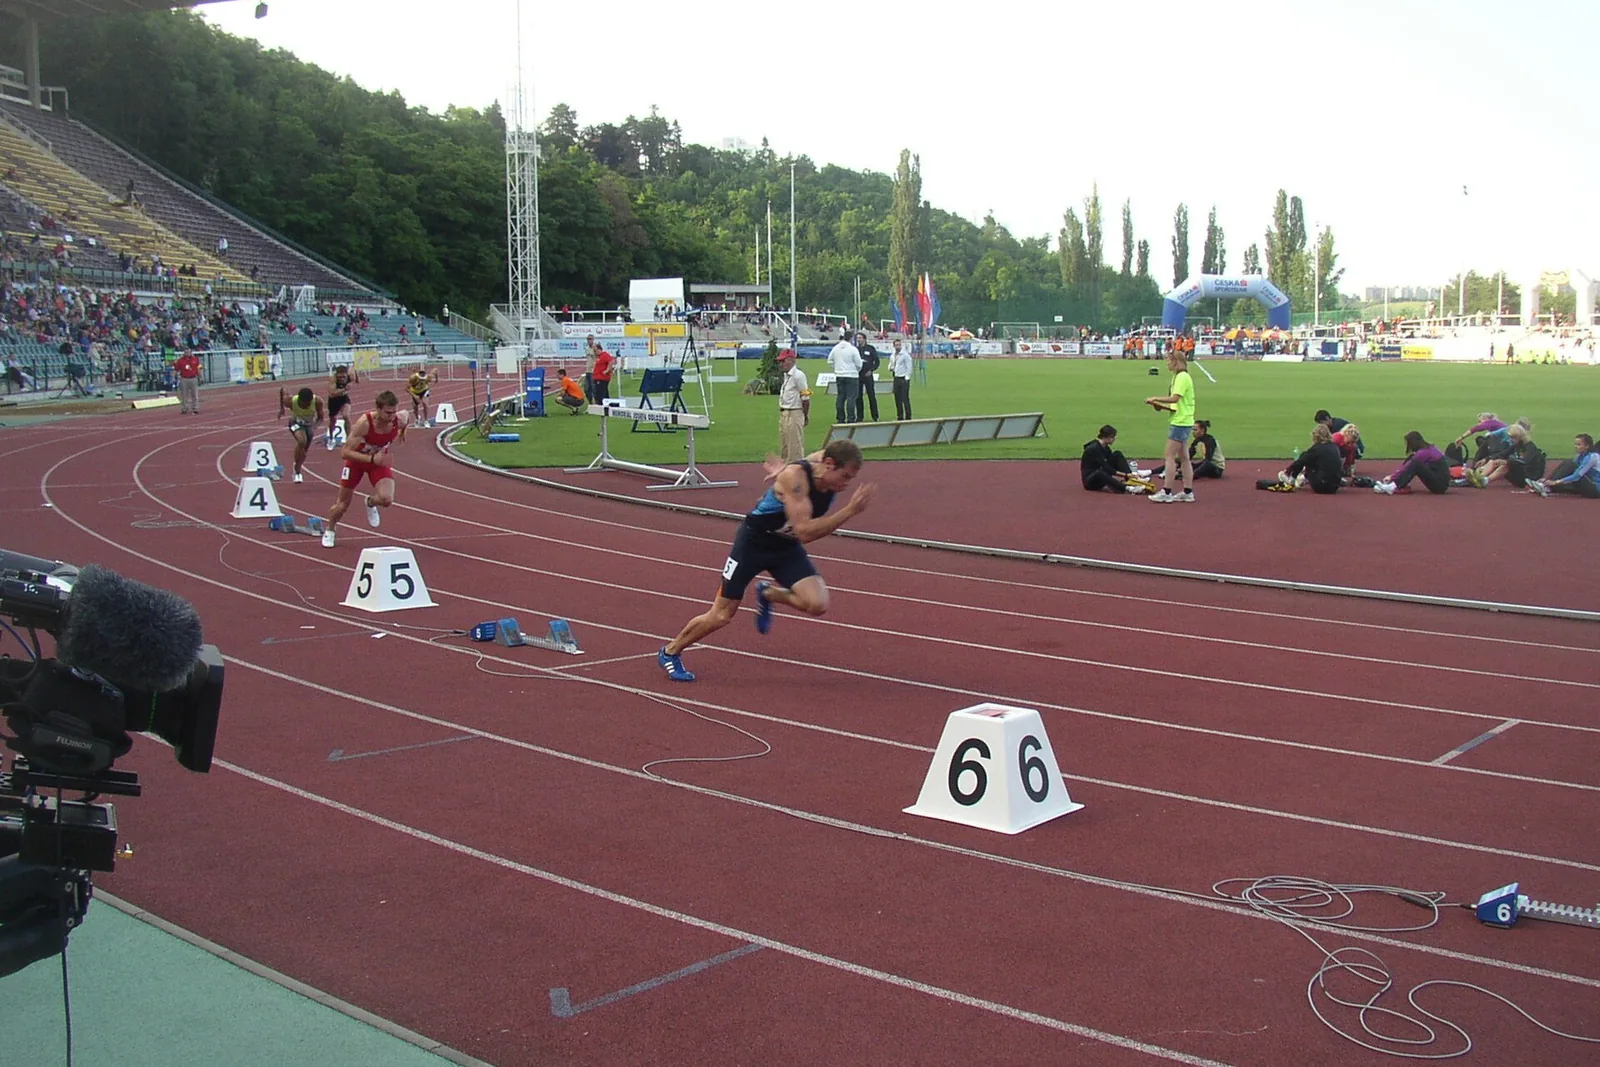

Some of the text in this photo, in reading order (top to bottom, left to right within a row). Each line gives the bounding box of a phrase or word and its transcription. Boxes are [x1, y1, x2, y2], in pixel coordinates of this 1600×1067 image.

[441, 408, 448, 420] 1
[333, 425, 342, 439] 2
[256, 448, 270, 467] 3
[249, 487, 268, 511] 4
[356, 562, 375, 599] 5
[390, 562, 415, 600] 5
[56, 735, 93, 750] FUJINON
[948, 738, 992, 807] 6
[1018, 734, 1050, 804] 6
[1497, 903, 1511, 922] 6
